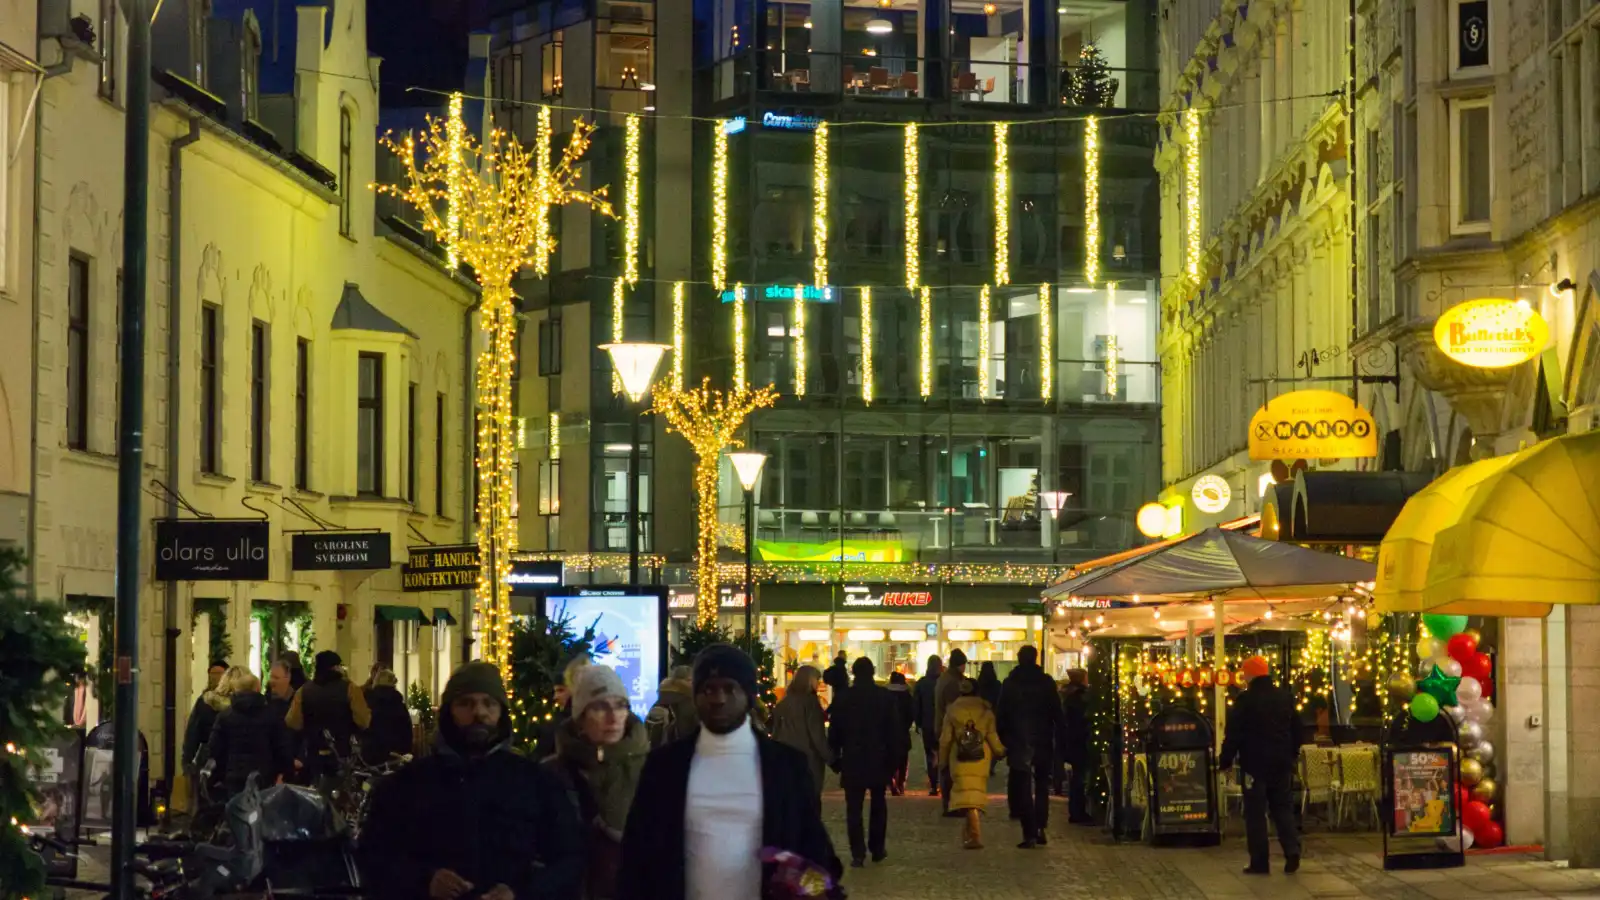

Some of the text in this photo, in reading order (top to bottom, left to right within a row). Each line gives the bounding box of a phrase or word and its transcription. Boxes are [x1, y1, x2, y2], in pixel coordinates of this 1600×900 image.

[765, 285, 823, 299] skadia
[1275, 419, 1370, 440] MANDO
[160, 537, 266, 561] olars ulla
[314, 540, 369, 551] CAROLINE
[315, 552, 369, 562] SVEDBOM
[1158, 752, 1196, 769] 40%
[1410, 752, 1439, 766] 50%
